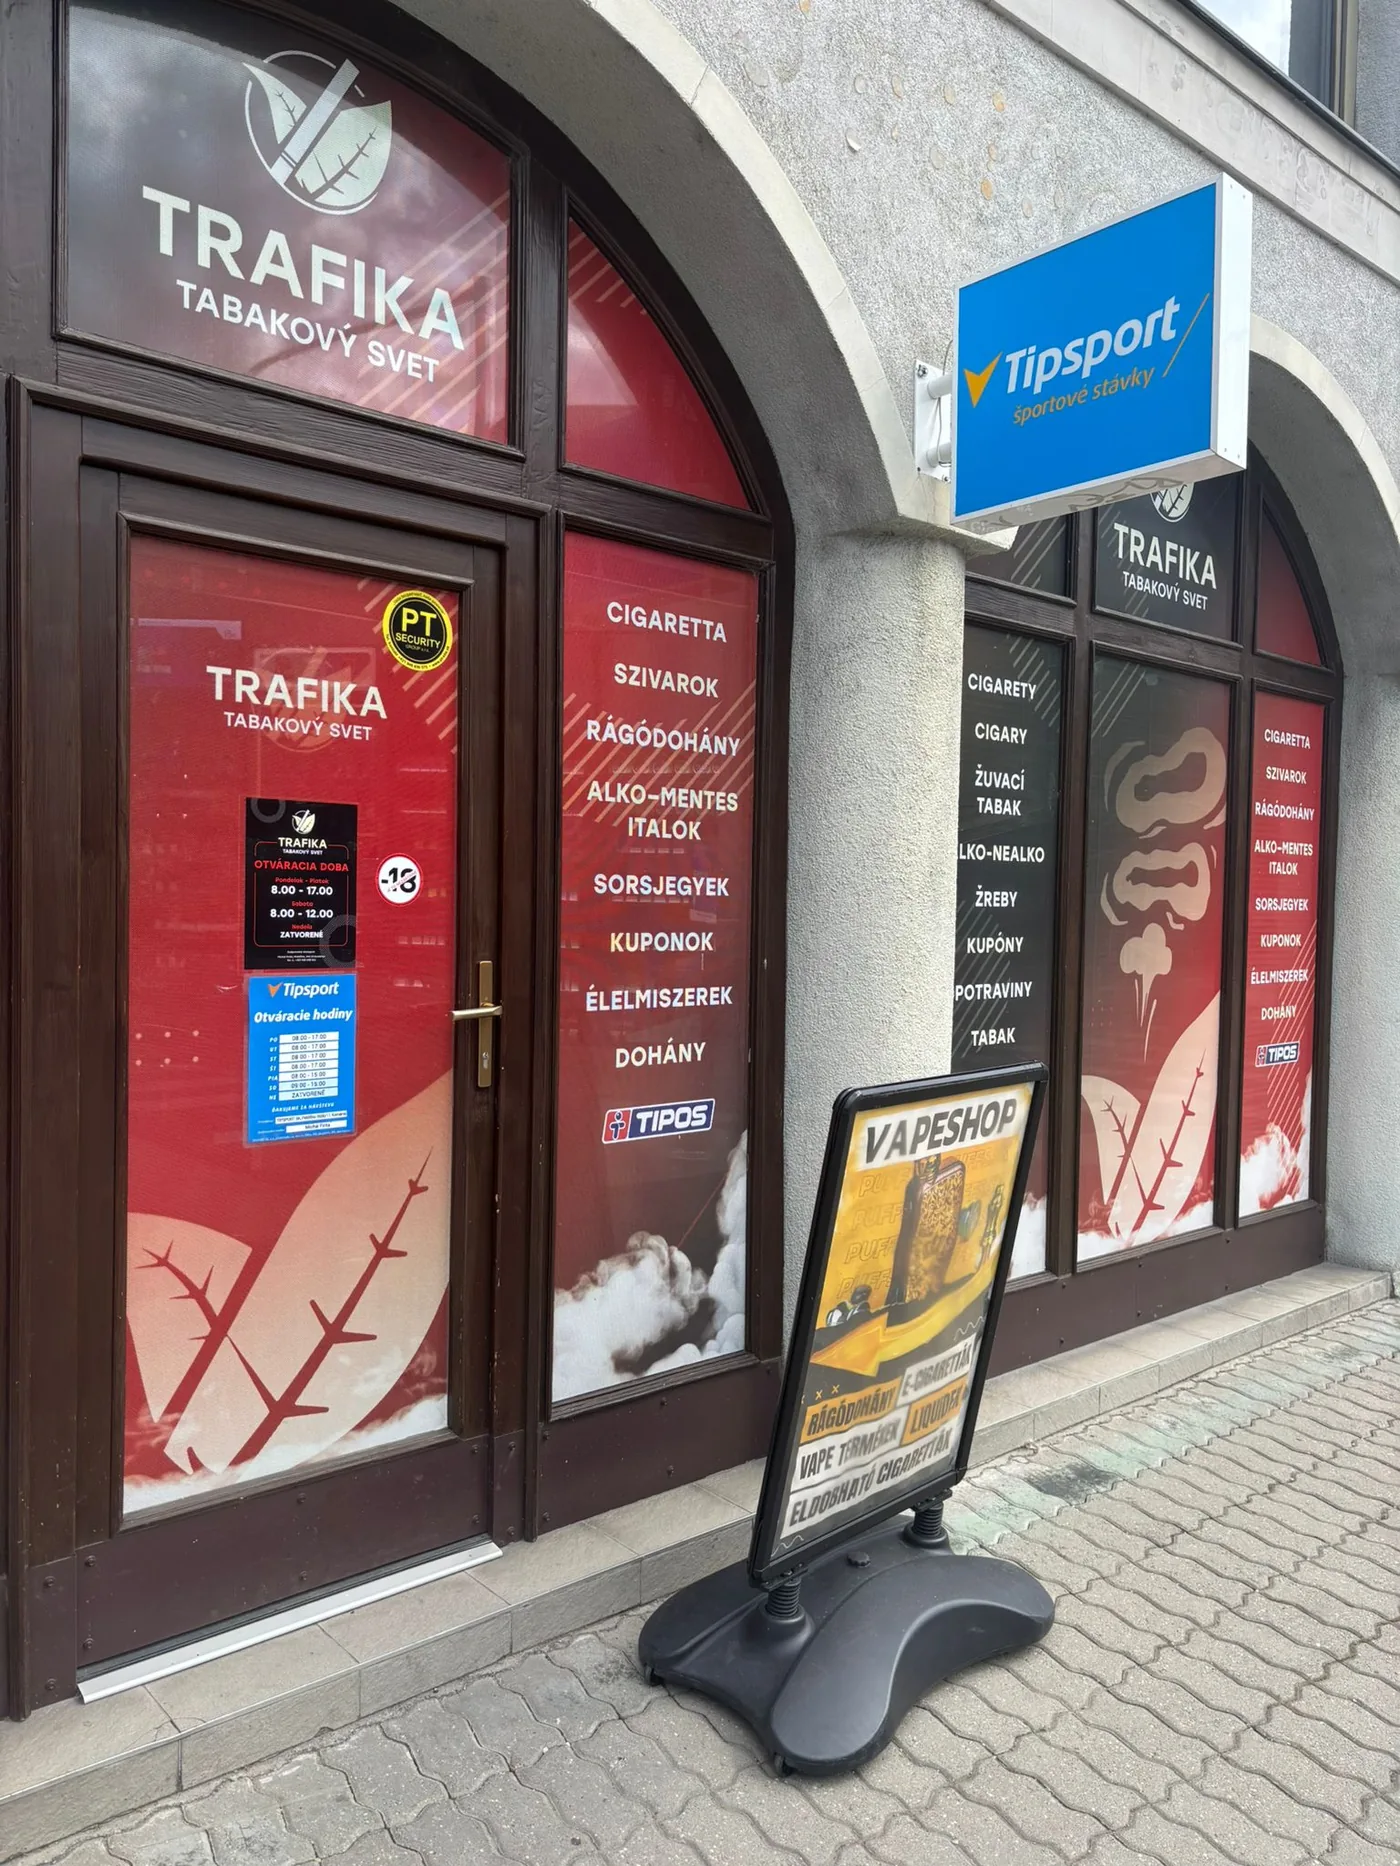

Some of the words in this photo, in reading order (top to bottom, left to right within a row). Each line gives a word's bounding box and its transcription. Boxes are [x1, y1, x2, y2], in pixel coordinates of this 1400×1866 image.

[142, 186, 465, 351] TRAFIKA
[176, 279, 358, 359] TABAKOVÝ
[367, 340, 440, 383] SVET
[1005, 295, 1181, 395] Tipsport
[1012, 385, 1089, 427] športové
[1092, 365, 1155, 402] stávky
[1114, 522, 1217, 590] TRAFIKA
[1122, 571, 1181, 603] TABAKOVÝ
[1183, 587, 1208, 611] SVET
[401, 607, 437, 637] PT
[606, 601, 727, 643] CIGARETTA
[395, 632, 441, 649] SECURITY
[206, 665, 388, 720] TRAFIKA
[614, 662, 719, 699] SZIVAROK
[967, 673, 1037, 700] CIGARETY
[223, 711, 323, 737] TABAKOVÝ
[329, 723, 373, 742] SVET
[586, 714, 741, 757] RÁGÓDOHÁNY
[974, 722, 1028, 745] CIGARY
[1264, 728, 1311, 749] CIGARETTA
[974, 763, 1026, 791] ŽUVACÍ
[1265, 765, 1307, 785] SZIVAROK
[976, 796, 1022, 816] TABAK
[1254, 798, 1315, 821] RÁGÓDOHÁNY
[628, 816, 702, 841] ITALOK
[278, 837, 328, 849] TRAFIKA
[956, 842, 1045, 863] LKO-NEALKO
[254, 858, 318, 872] OTVÁRACIA
[320, 863, 349, 872] DOBA
[1269, 861, 1298, 876] ITALOK
[270, 885, 296, 896] 8.00
[306, 886, 333, 896] 17.00
[593, 873, 730, 897] SORSJEGYEK
[975, 884, 1018, 908] ŽREBY
[270, 908, 295, 918] 8.00
[305, 909, 334, 919] 12.00
[1255, 897, 1309, 911] SORSJEGYEK
[279, 930, 324, 939] ZATVORENÉ
[610, 931, 714, 953] KUPONOK
[966, 931, 1024, 954] KUPÓNY
[1260, 934, 1302, 948] KUPONOK
[1251, 967, 1309, 985] ÉLELMISZEREK
[283, 982, 339, 999] Tipsport
[585, 984, 733, 1012] ÉLELMISZEREK
[955, 981, 1033, 1001] POTRAVINY
[254, 1009, 311, 1024] Otváracie
[312, 1008, 354, 1022] hodiny
[1261, 1002, 1297, 1021] DOHÁNY
[970, 1026, 1017, 1047] TABAK
[615, 1036, 707, 1069] DOHÁNY
[1268, 1045, 1298, 1063] TIPOS
[636, 1104, 708, 1133] TIPOS
[865, 1098, 1018, 1165] VAPESHOP
[806, 1385, 897, 1437] RÁGÓDOHÁNY
[910, 1384, 963, 1434] LIQUIDEK
[799, 1445, 834, 1481] VAPE
[838, 1416, 901, 1466] TERMÉKEK
[789, 1464, 874, 1527] ELDOBHATÓ
[876, 1426, 953, 1485] CIGARETTÁK
